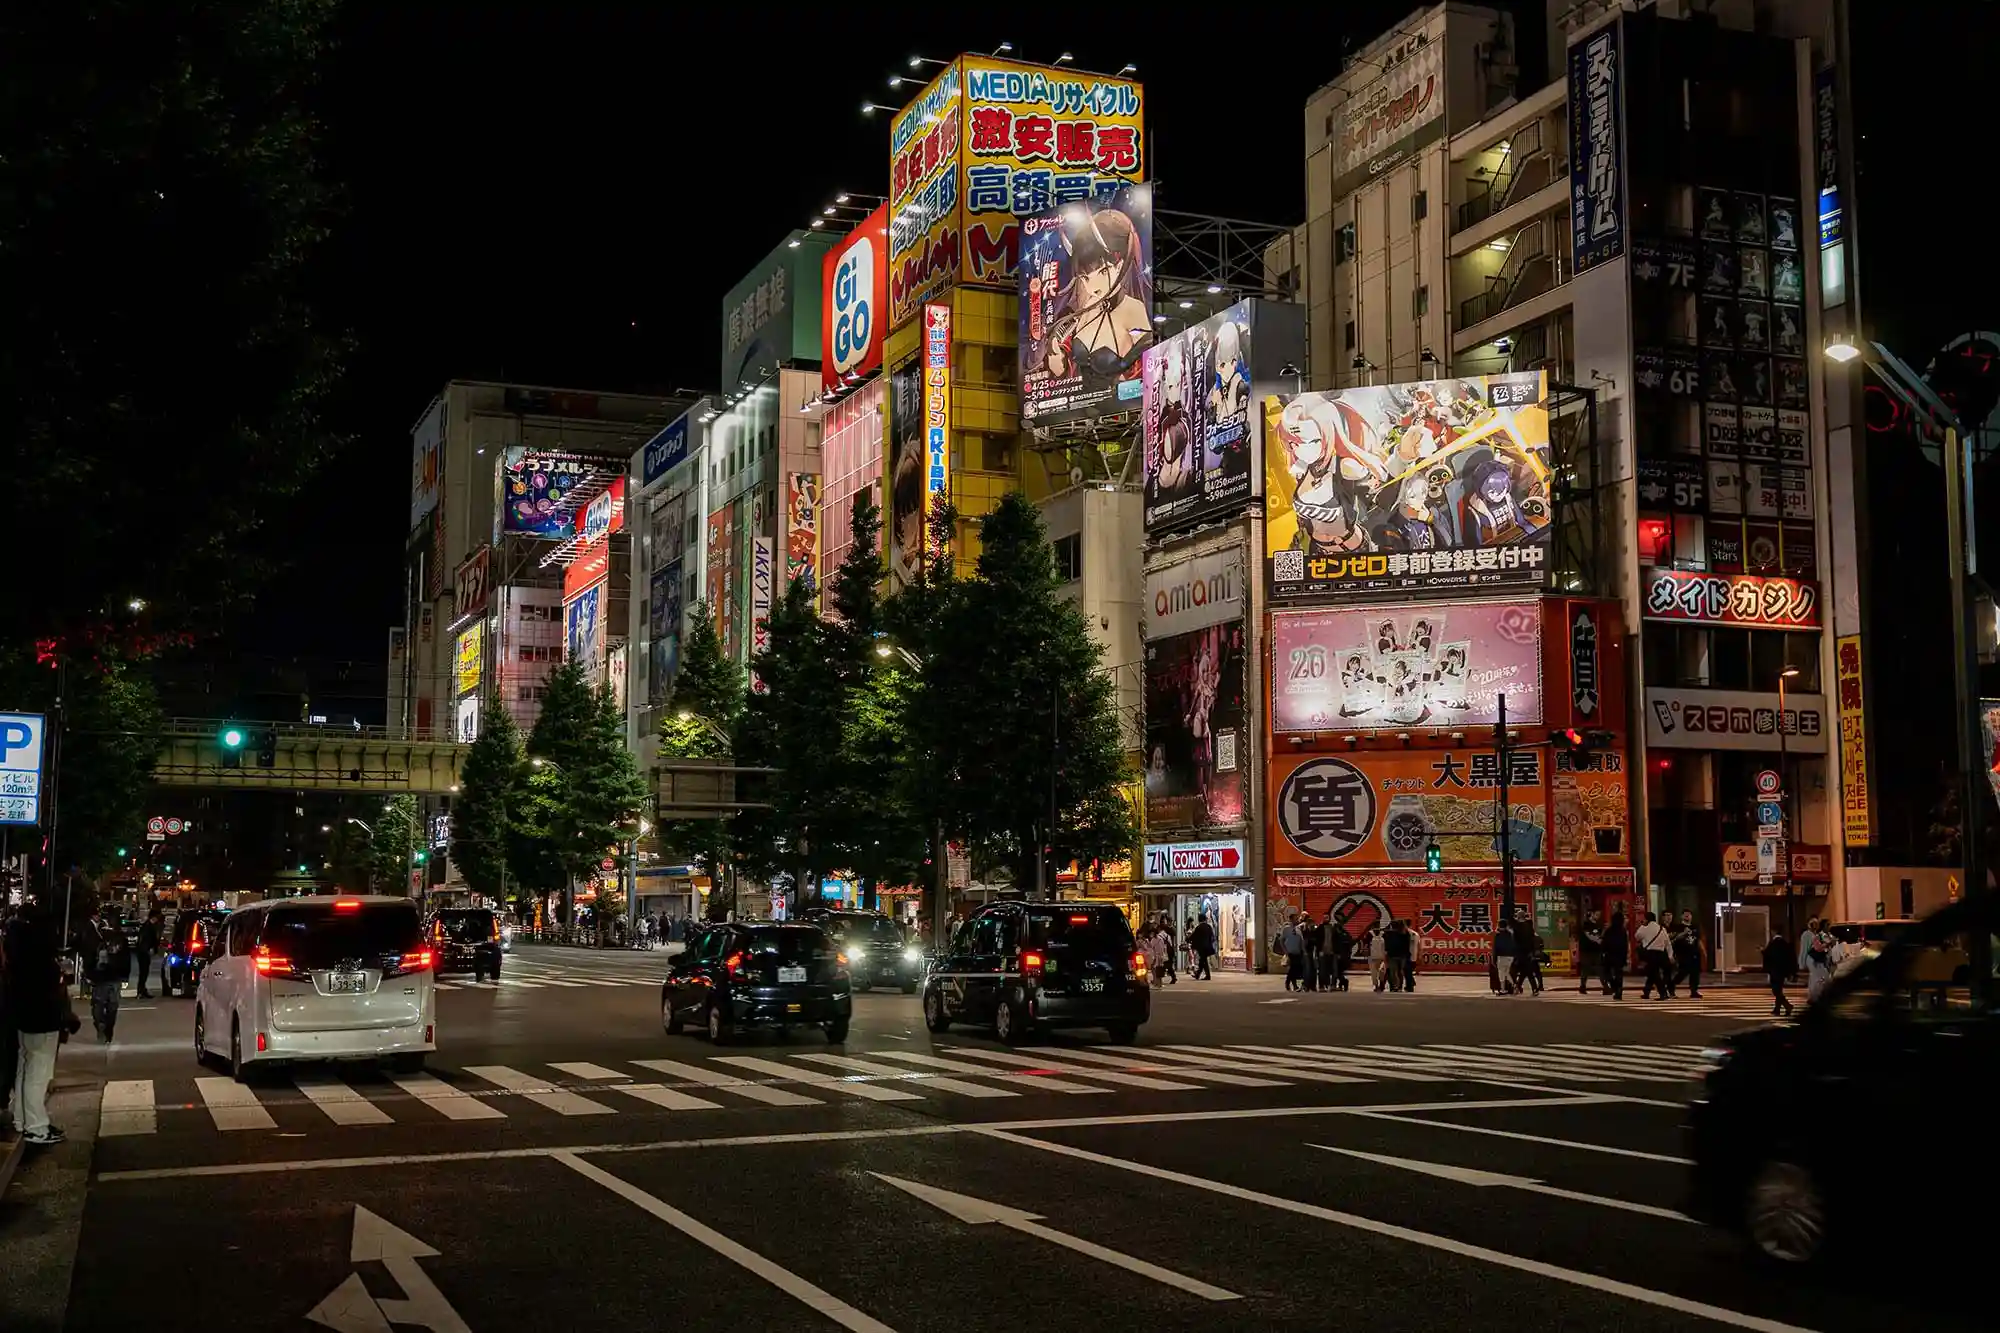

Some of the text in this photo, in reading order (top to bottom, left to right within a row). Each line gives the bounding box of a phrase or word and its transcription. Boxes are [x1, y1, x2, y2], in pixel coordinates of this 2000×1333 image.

[967, 70, 1139, 116] MEDIAリサイクル
[968, 105, 1138, 171] 激安販売
[1666, 262, 1696, 288] 7F
[1669, 370, 1699, 395] 6F
[1673, 482, 1703, 507] 5F
[755, 540, 770, 593] AKKY
[1308, 545, 1544, 579] ゼンゼロ事前登録受付中
[1155, 572, 1233, 617] amiami
[1648, 576, 1816, 622] メイドカジノ
[1683, 704, 1821, 737] スマホ修理王
[0, 722, 33, 763] P
[1431, 752, 1540, 788] 大黒屋
[1556, 751, 1623, 774] 質買取
[1382, 777, 1425, 791] チケット
[1289, 772, 1362, 847] 質
[1147, 845, 1171, 876] ZIN
[1173, 850, 1223, 869] COMIC ZIN
[1420, 936, 1492, 950] Daikok
